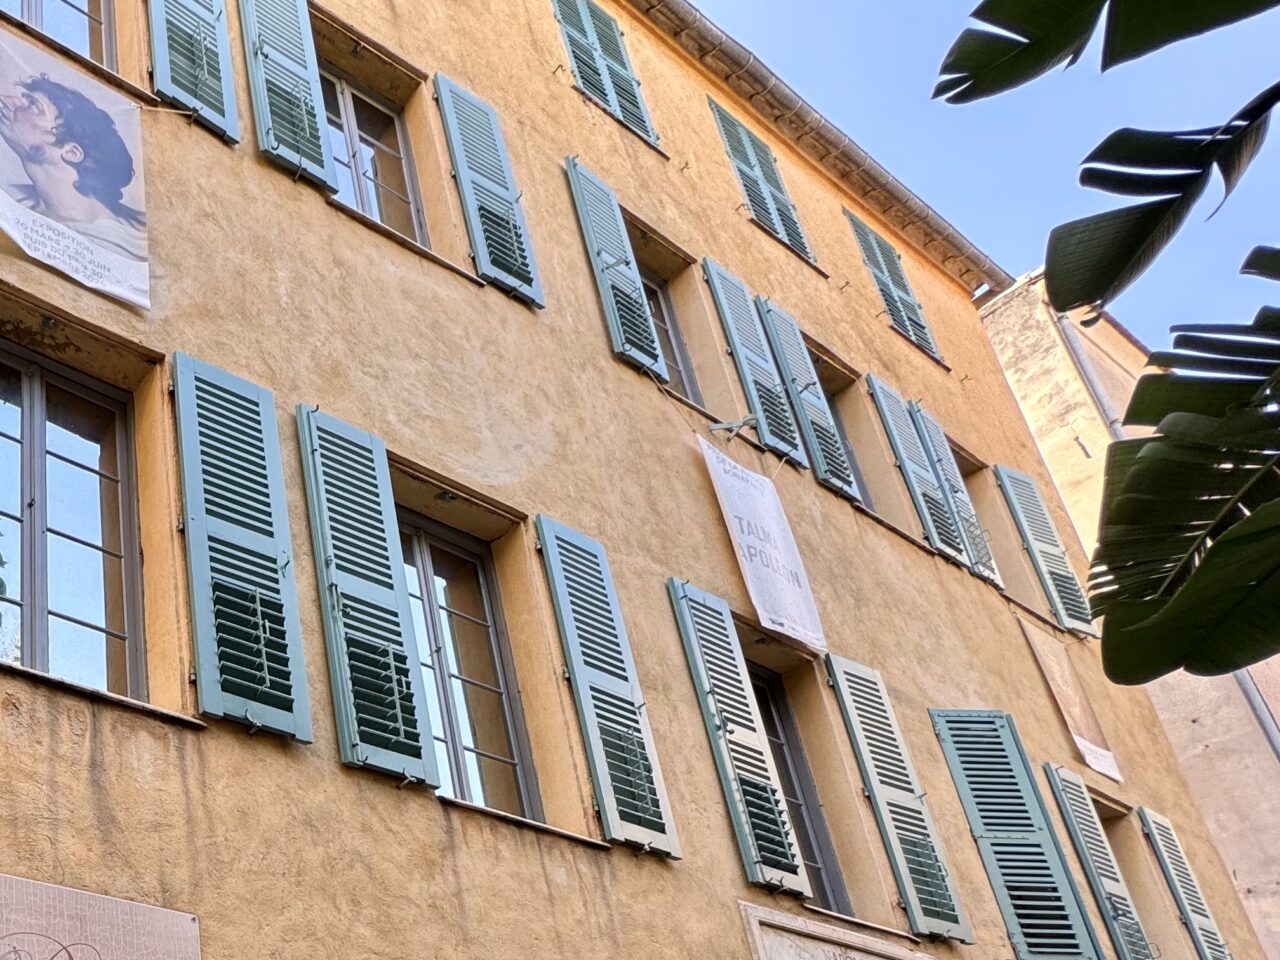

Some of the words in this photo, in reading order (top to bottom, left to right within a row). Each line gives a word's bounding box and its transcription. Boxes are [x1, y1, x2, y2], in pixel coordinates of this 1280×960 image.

[30, 226, 60, 246] MARS
[87, 258, 111, 273] JUIN
[32, 218, 94, 256] EXPOSITION
